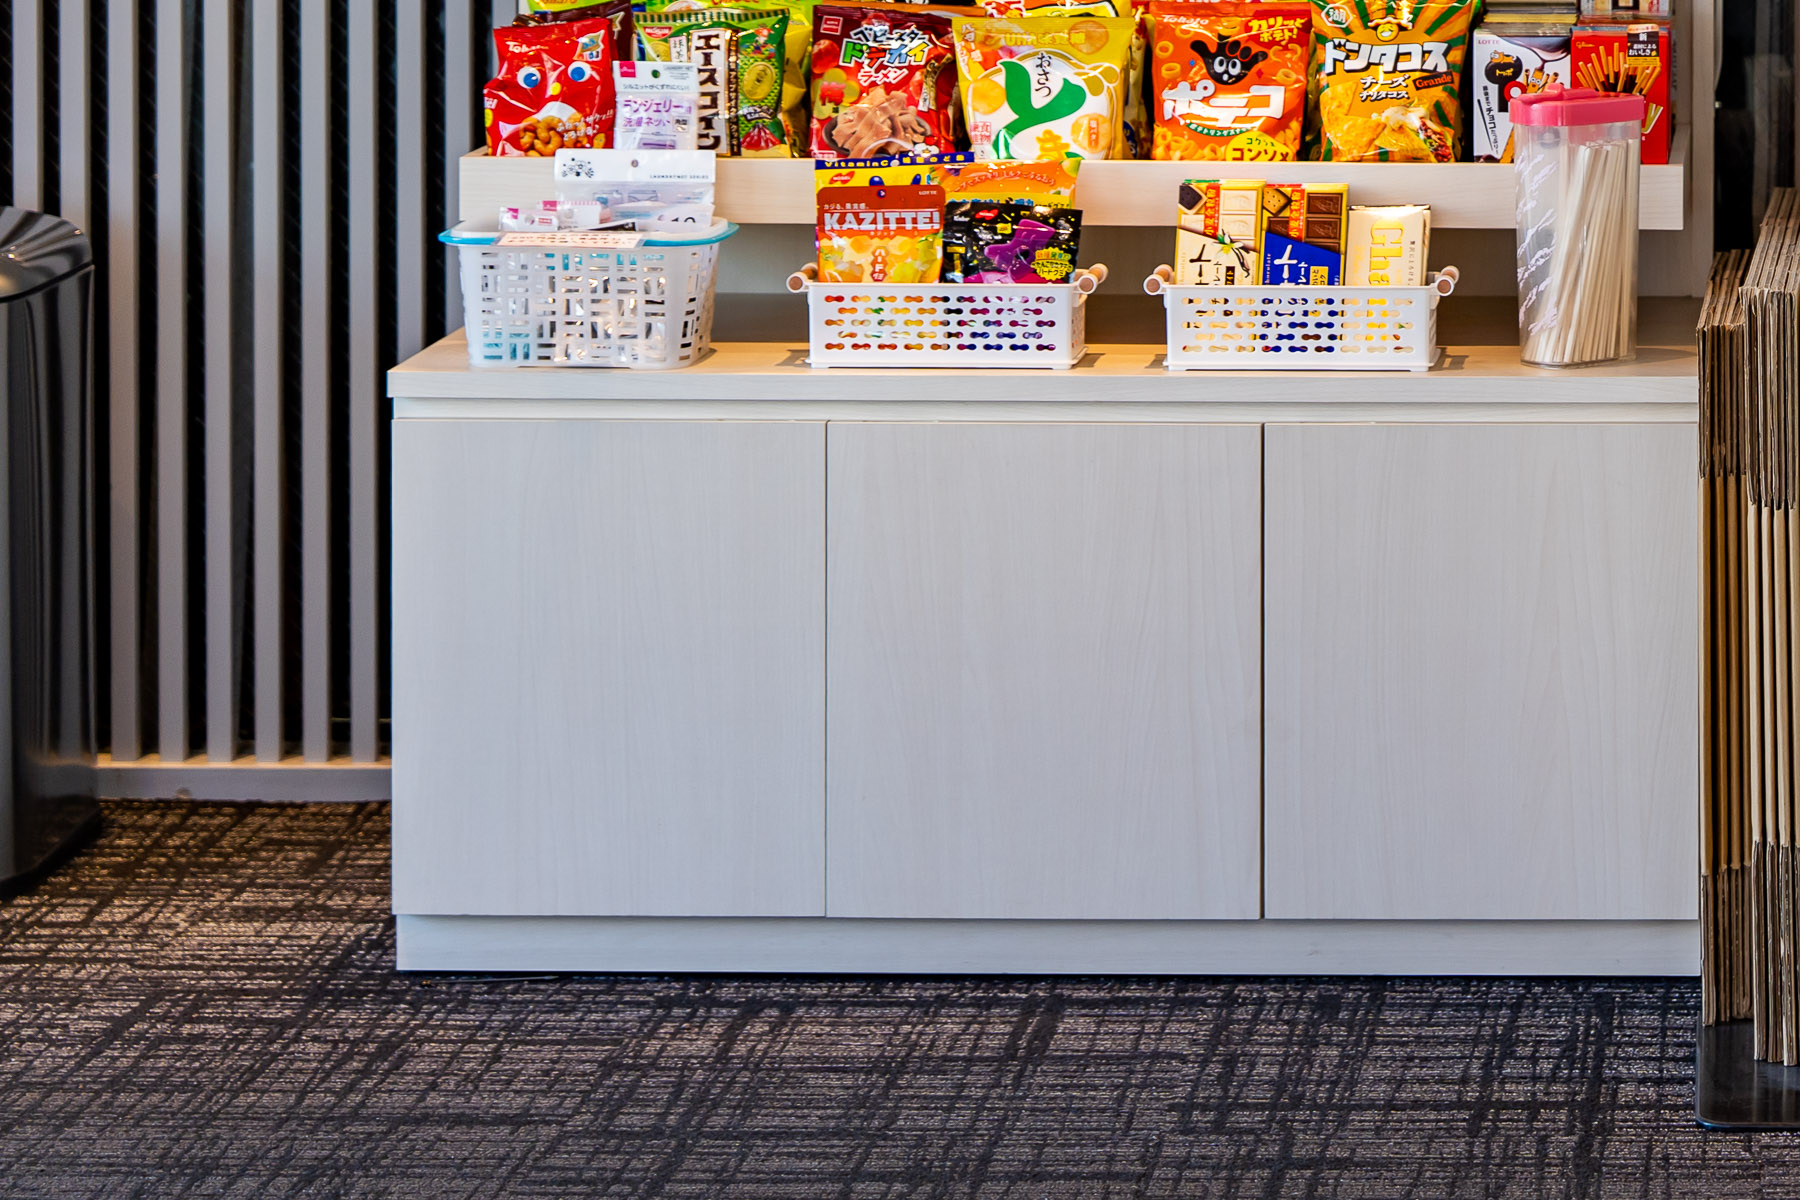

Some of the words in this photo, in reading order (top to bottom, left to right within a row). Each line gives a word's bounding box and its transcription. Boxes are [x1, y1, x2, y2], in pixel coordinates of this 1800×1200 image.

[1324, 37, 1450, 75] ドンタコス
[1417, 74, 1452, 88] Grande
[1162, 80, 1285, 127] ポテコ
[823, 210, 940, 230] KAZITTE!
